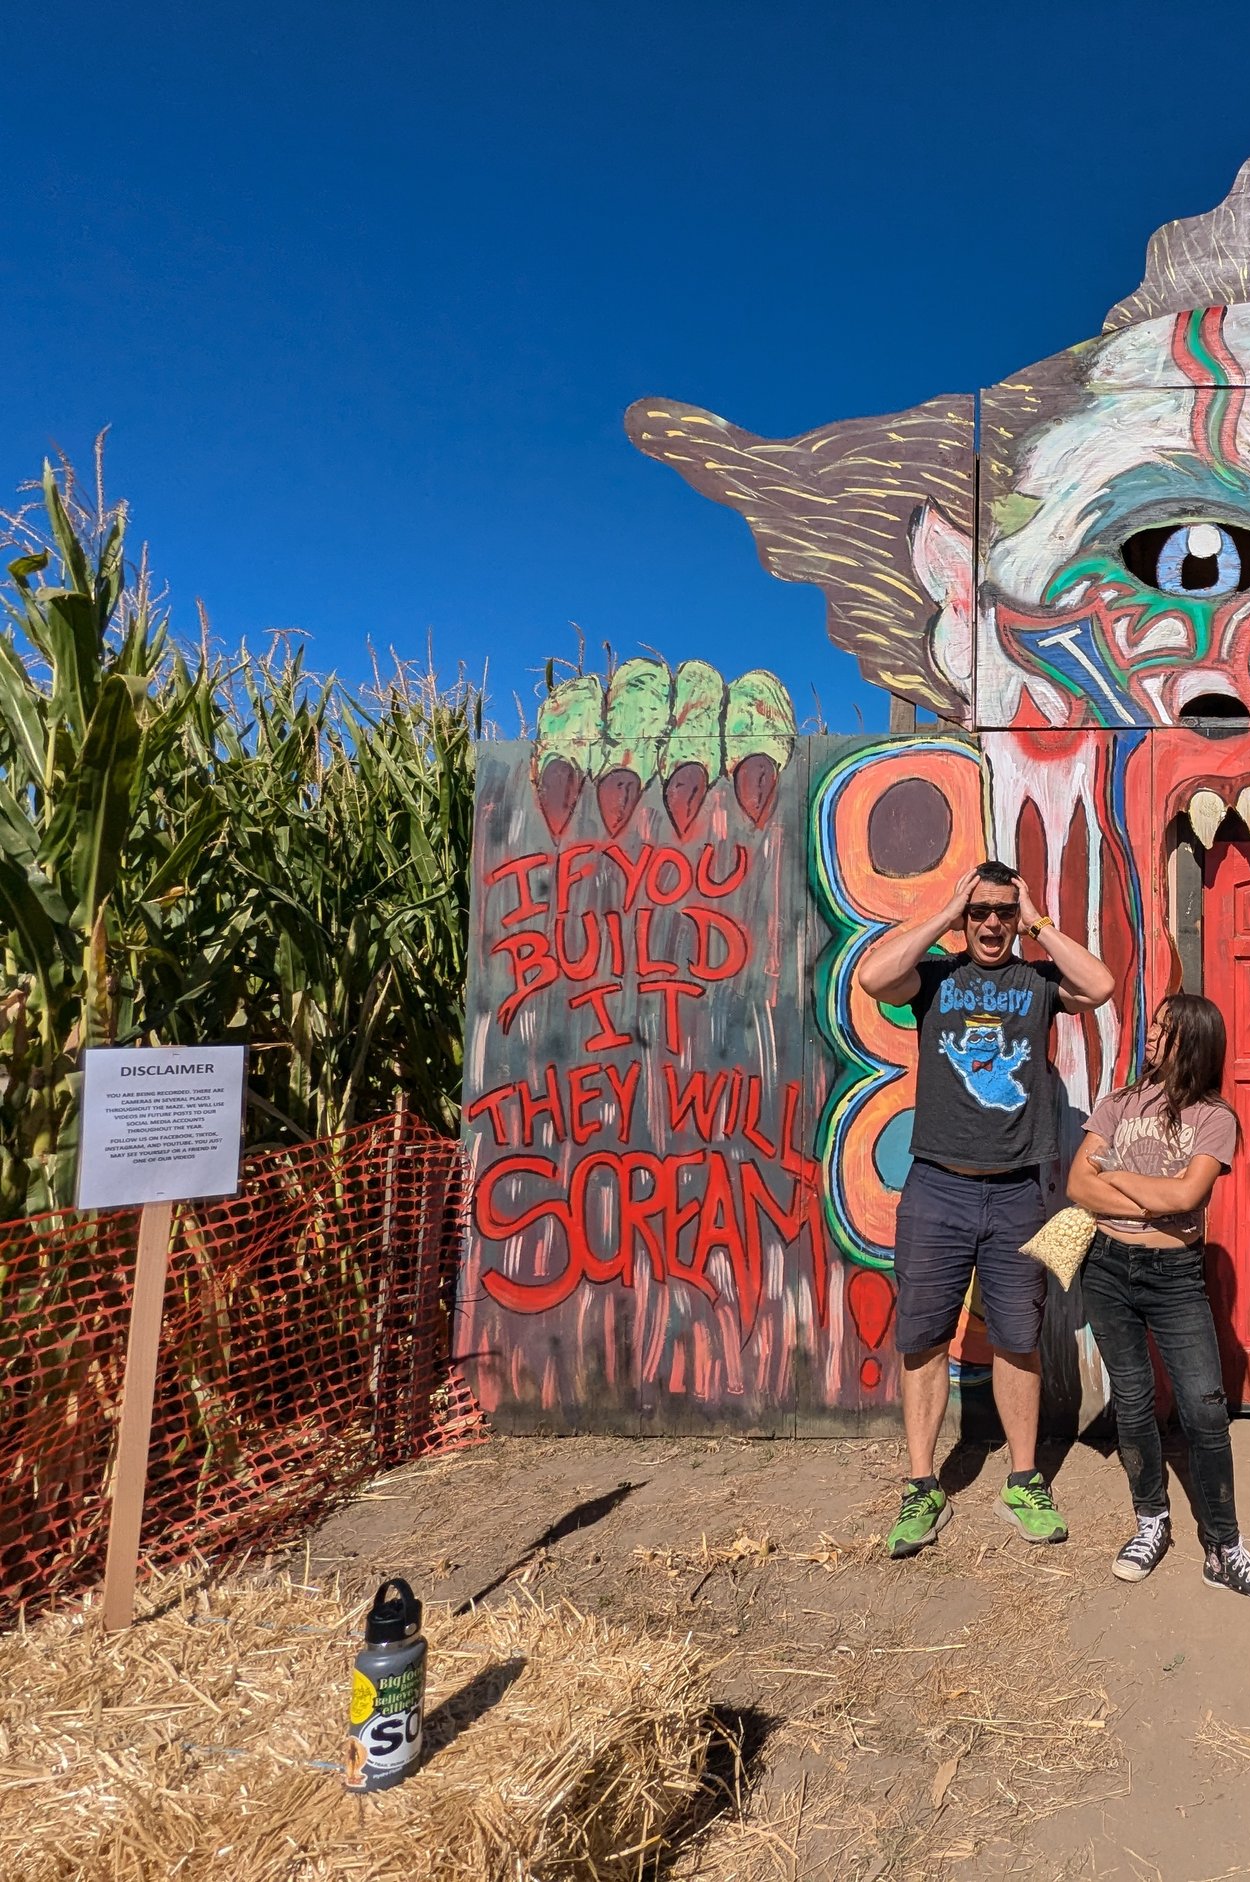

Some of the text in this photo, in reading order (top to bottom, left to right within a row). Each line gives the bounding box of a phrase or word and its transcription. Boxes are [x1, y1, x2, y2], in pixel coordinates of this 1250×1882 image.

[485, 842, 748, 927] IF YOU
[490, 906, 750, 1035] BUILD
[570, 980, 706, 1055] IT
[120, 1063, 215, 1077] DISCLAIMER
[468, 1060, 818, 1179] THEY WILL
